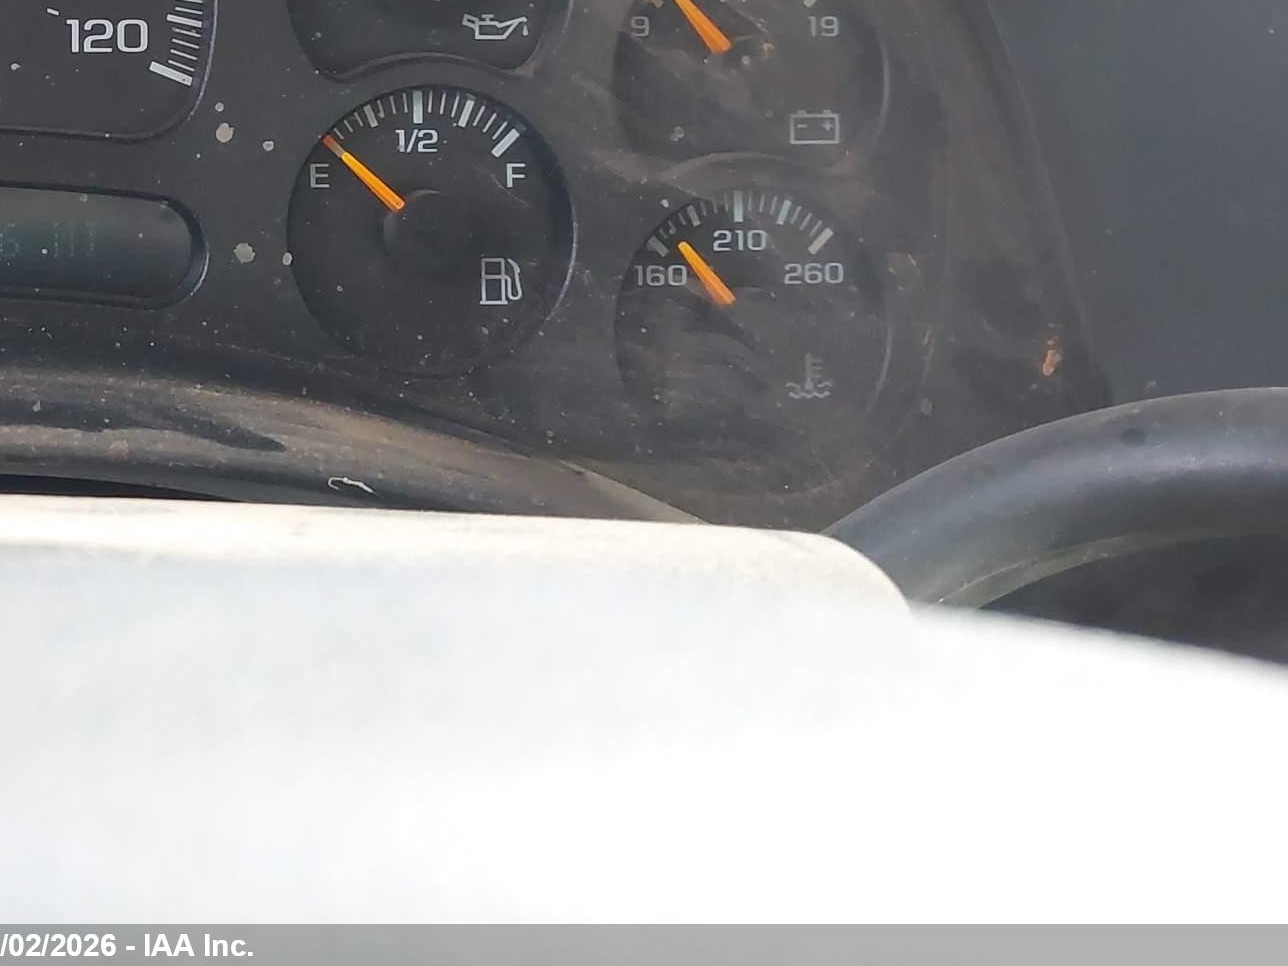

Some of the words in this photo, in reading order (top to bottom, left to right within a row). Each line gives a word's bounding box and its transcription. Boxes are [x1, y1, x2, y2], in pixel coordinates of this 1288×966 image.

[67, 20, 147, 52] 120
[630, 16, 650, 37] 9
[807, 16, 839, 37] 19
[396, 130, 437, 152] 1/2
[311, 164, 329, 187] E
[507, 164, 525, 187] F
[714, 230, 768, 251] 210
[634, 265, 688, 286] 160
[783, 263, 845, 285] 260
